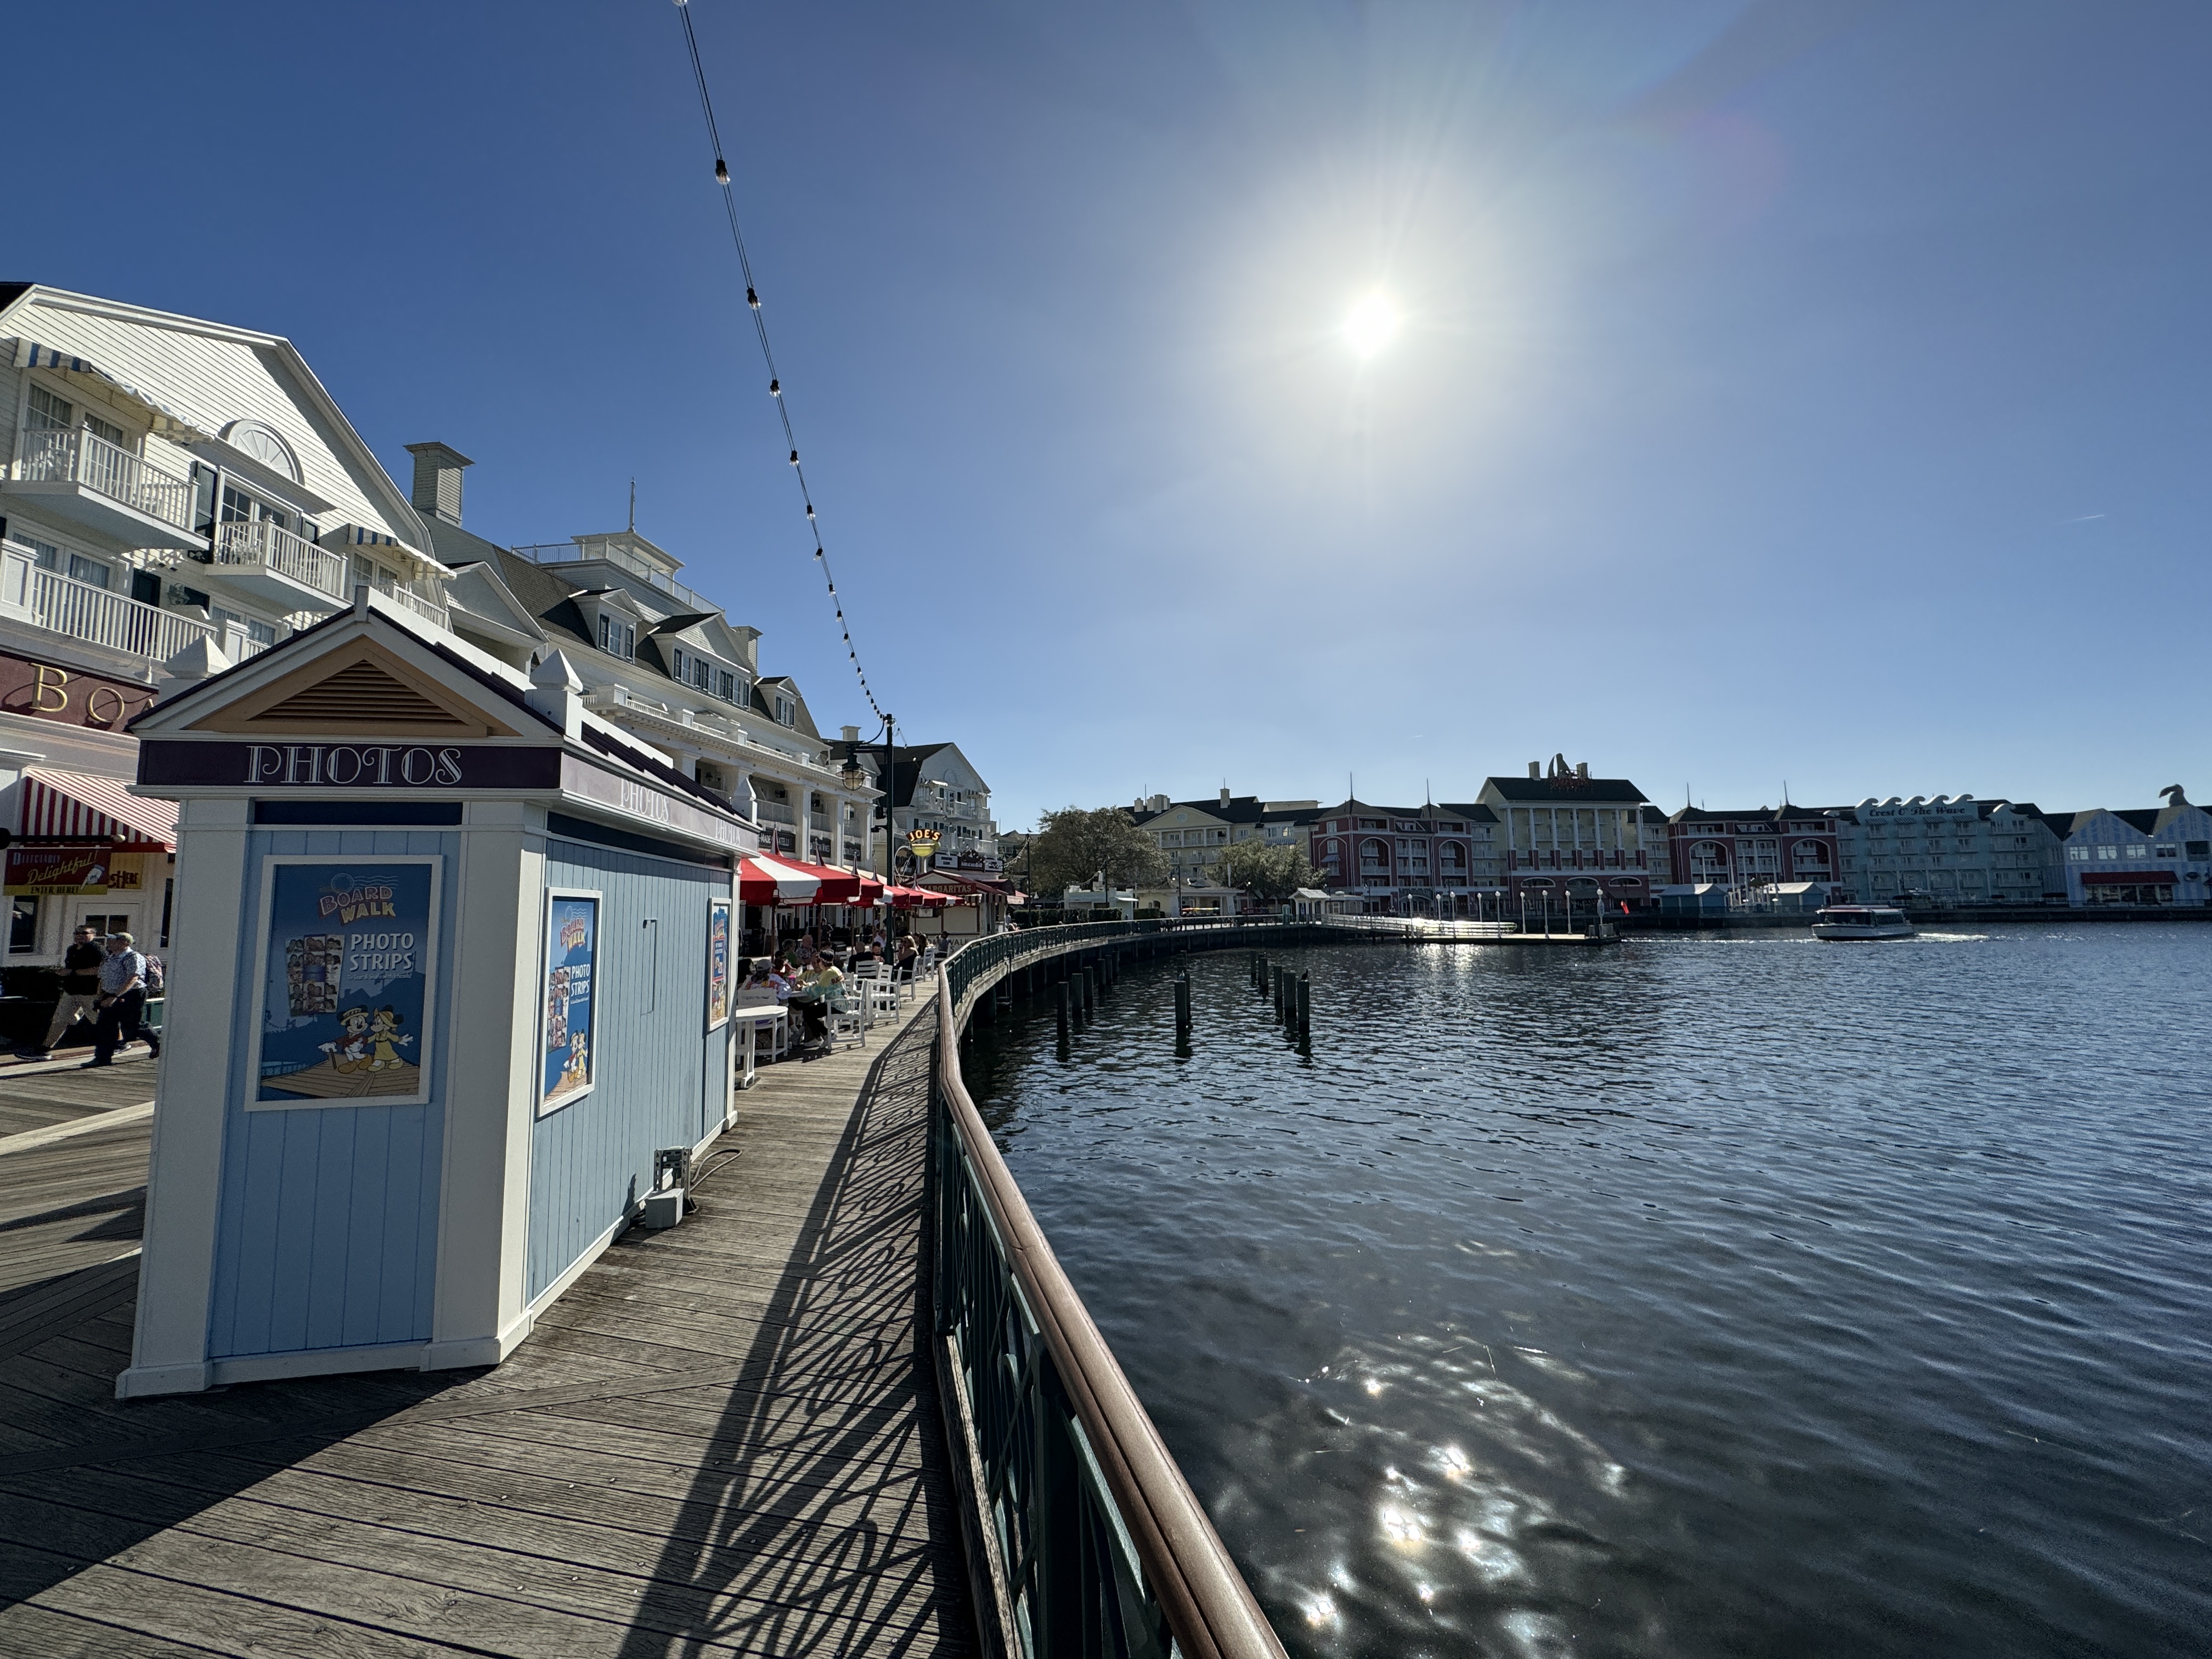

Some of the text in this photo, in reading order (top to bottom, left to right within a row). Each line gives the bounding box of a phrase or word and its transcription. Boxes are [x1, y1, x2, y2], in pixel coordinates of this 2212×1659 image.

[243, 746, 462, 785] PHOTOS
[619, 778, 669, 822] PHOTOS
[1869, 808, 1895, 816] Crest
[1911, 806, 1932, 815] The
[1935, 806, 1966, 814] Wave
[909, 828, 940, 842] JOE'S
[30, 884, 80, 894] ENTER HERE!
[319, 885, 393, 916] BOARD
[340, 901, 396, 924] WALK
[561, 918, 585, 943] BOARD
[351, 933, 414, 951] PHOTO
[349, 952, 413, 972] STRIPS
[572, 963, 590, 979] PHOTO
[571, 980, 590, 997] STRIPS
